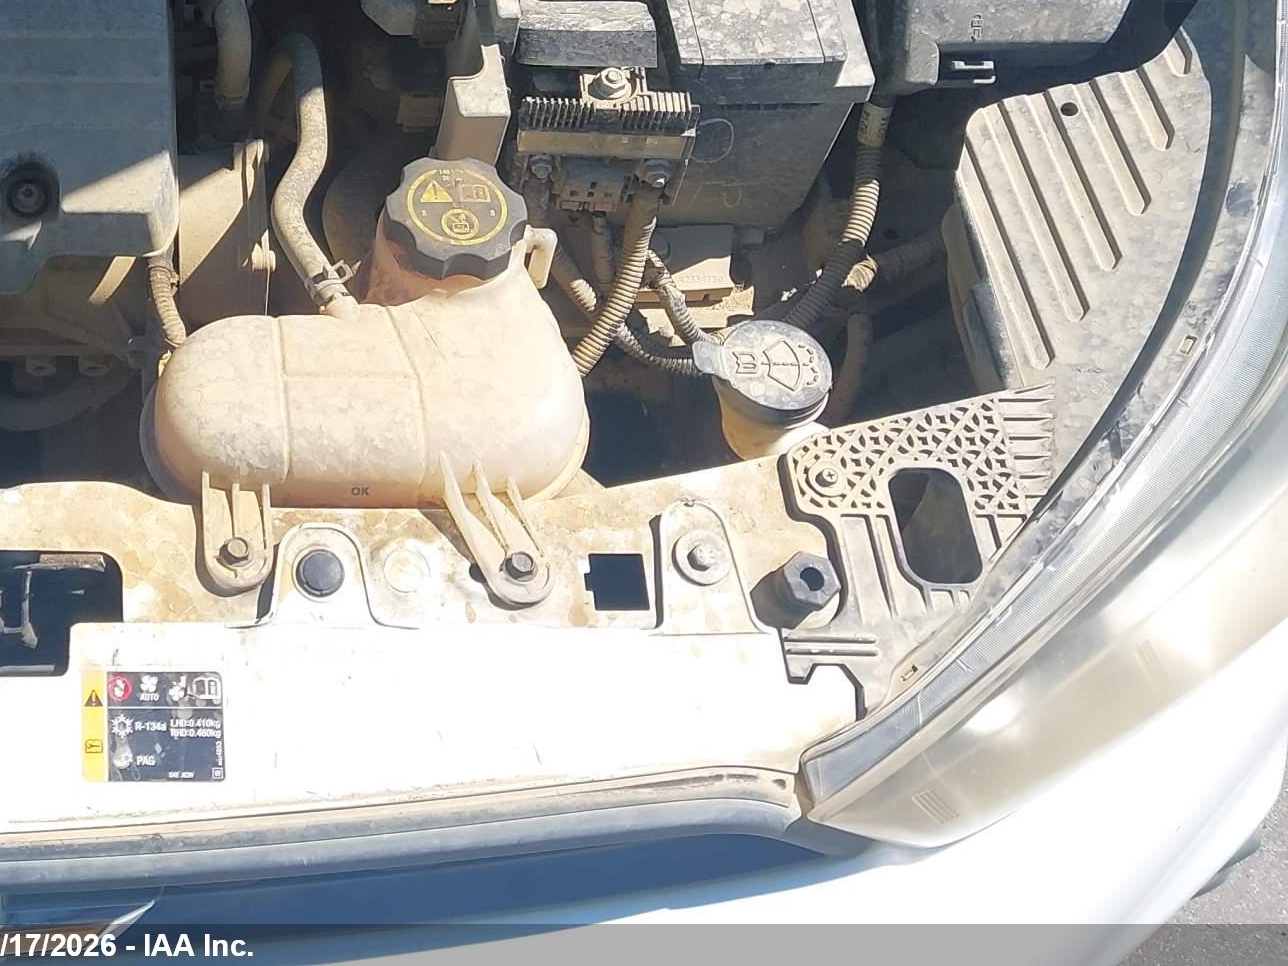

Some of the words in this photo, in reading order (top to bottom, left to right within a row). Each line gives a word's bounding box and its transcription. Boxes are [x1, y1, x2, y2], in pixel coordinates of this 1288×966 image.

[351, 486, 370, 496] OK
[139, 692, 160, 701] AUTO
[134, 722, 167, 731] R-134a
[136, 755, 156, 766] PAG
